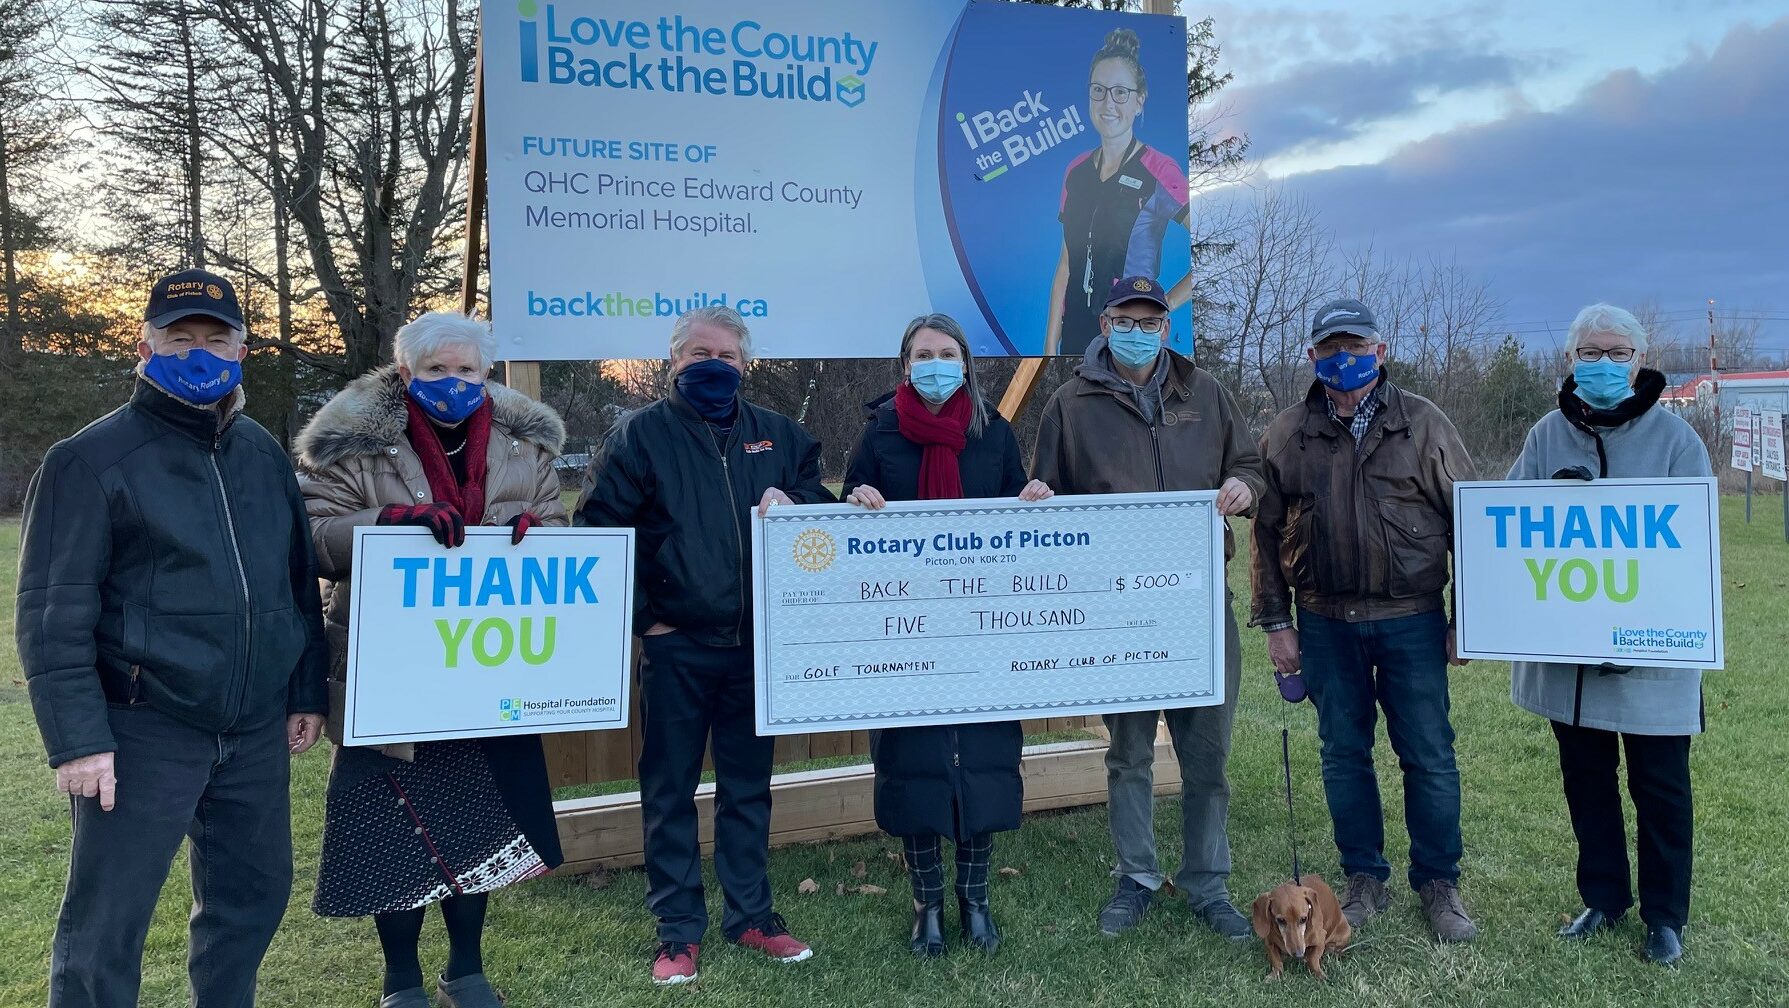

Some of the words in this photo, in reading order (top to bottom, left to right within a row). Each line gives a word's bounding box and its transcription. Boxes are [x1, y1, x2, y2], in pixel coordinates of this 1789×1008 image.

[547, 4, 650, 49] Love
[657, 15, 726, 56] the
[731, 20, 878, 76] County
[548, 46, 654, 90] Back
[658, 56, 727, 95] the
[734, 60, 832, 101] Build
[972, 89, 1050, 144] Back
[523, 136, 623, 160] FUTURE
[628, 141, 679, 162] SITE
[684, 144, 717, 164] OF
[975, 150, 1003, 171] the
[1002, 104, 1085, 167] Build!
[524, 170, 590, 195] QHC
[598, 174, 675, 198] Prince
[684, 178, 773, 201] Edward
[782, 181, 863, 209] County
[526, 205, 645, 230] Memorial
[653, 209, 758, 237] Hospital.
[168, 281, 204, 292] Rotary
[200, 378, 221, 390] Rotary
[1485, 504, 1682, 549] THANK
[847, 536, 926, 557] Rotary
[932, 532, 983, 551] Club
[990, 530, 1013, 549] of
[1019, 529, 1090, 548] Picton
[925, 557, 957, 567] Picton,
[960, 556, 975, 565] ON
[393, 556, 600, 607] THANK
[861, 580, 910, 600] BACK
[940, 577, 988, 594] THE
[1012, 573, 1068, 592] BUILD
[1523, 558, 1639, 603] YOU
[885, 615, 927, 636] FIVE
[970, 608, 1086, 630] THOUSAND
[1619, 627, 1644, 637] Love
[1647, 628, 1664, 638] the
[1665, 628, 1707, 640] County
[434, 616, 556, 668] YOU
[1619, 637, 1645, 646] Back
[1647, 638, 1664, 647] the
[1666, 638, 1694, 648] Build
[803, 665, 840, 680] GOLF
[852, 661, 936, 675] TOURNAMENT
[1011, 658, 1060, 672] ROTARY
[1069, 657, 1095, 666] CLUB
[1102, 654, 1117, 664] OF
[1124, 650, 1169, 661] PICTON
[523, 699, 562, 710] Hospital
[565, 697, 616, 708] Foundation
